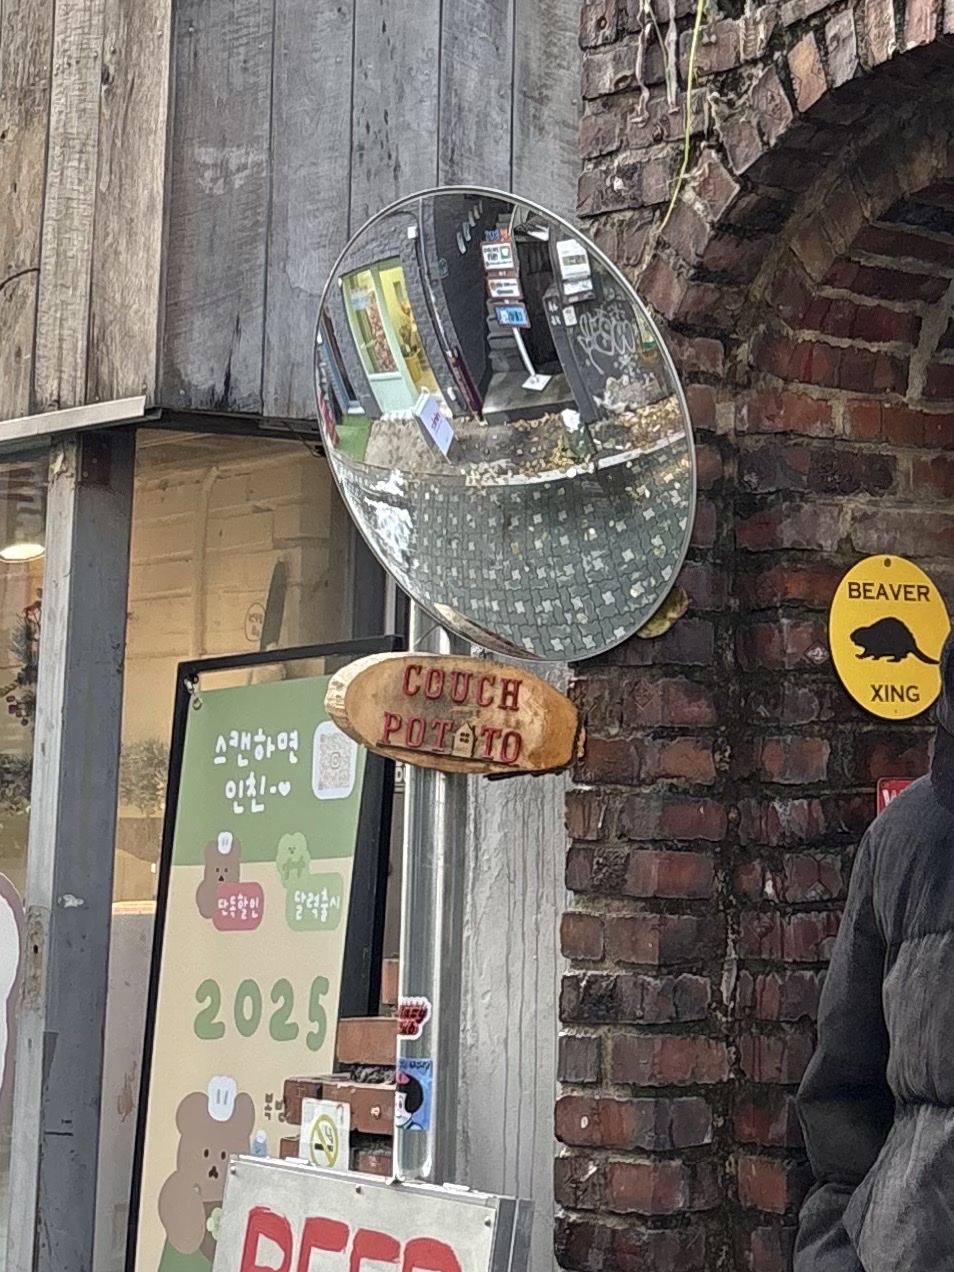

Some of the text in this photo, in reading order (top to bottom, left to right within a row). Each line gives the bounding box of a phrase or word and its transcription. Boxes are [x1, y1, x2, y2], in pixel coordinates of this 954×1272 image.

[848, 582, 931, 602] BEAVER
[402, 664, 523, 712] COUCH
[870, 684, 920, 702] XING
[213, 727, 298, 767] 스캔하면
[193, 975, 330, 1052] 2025
